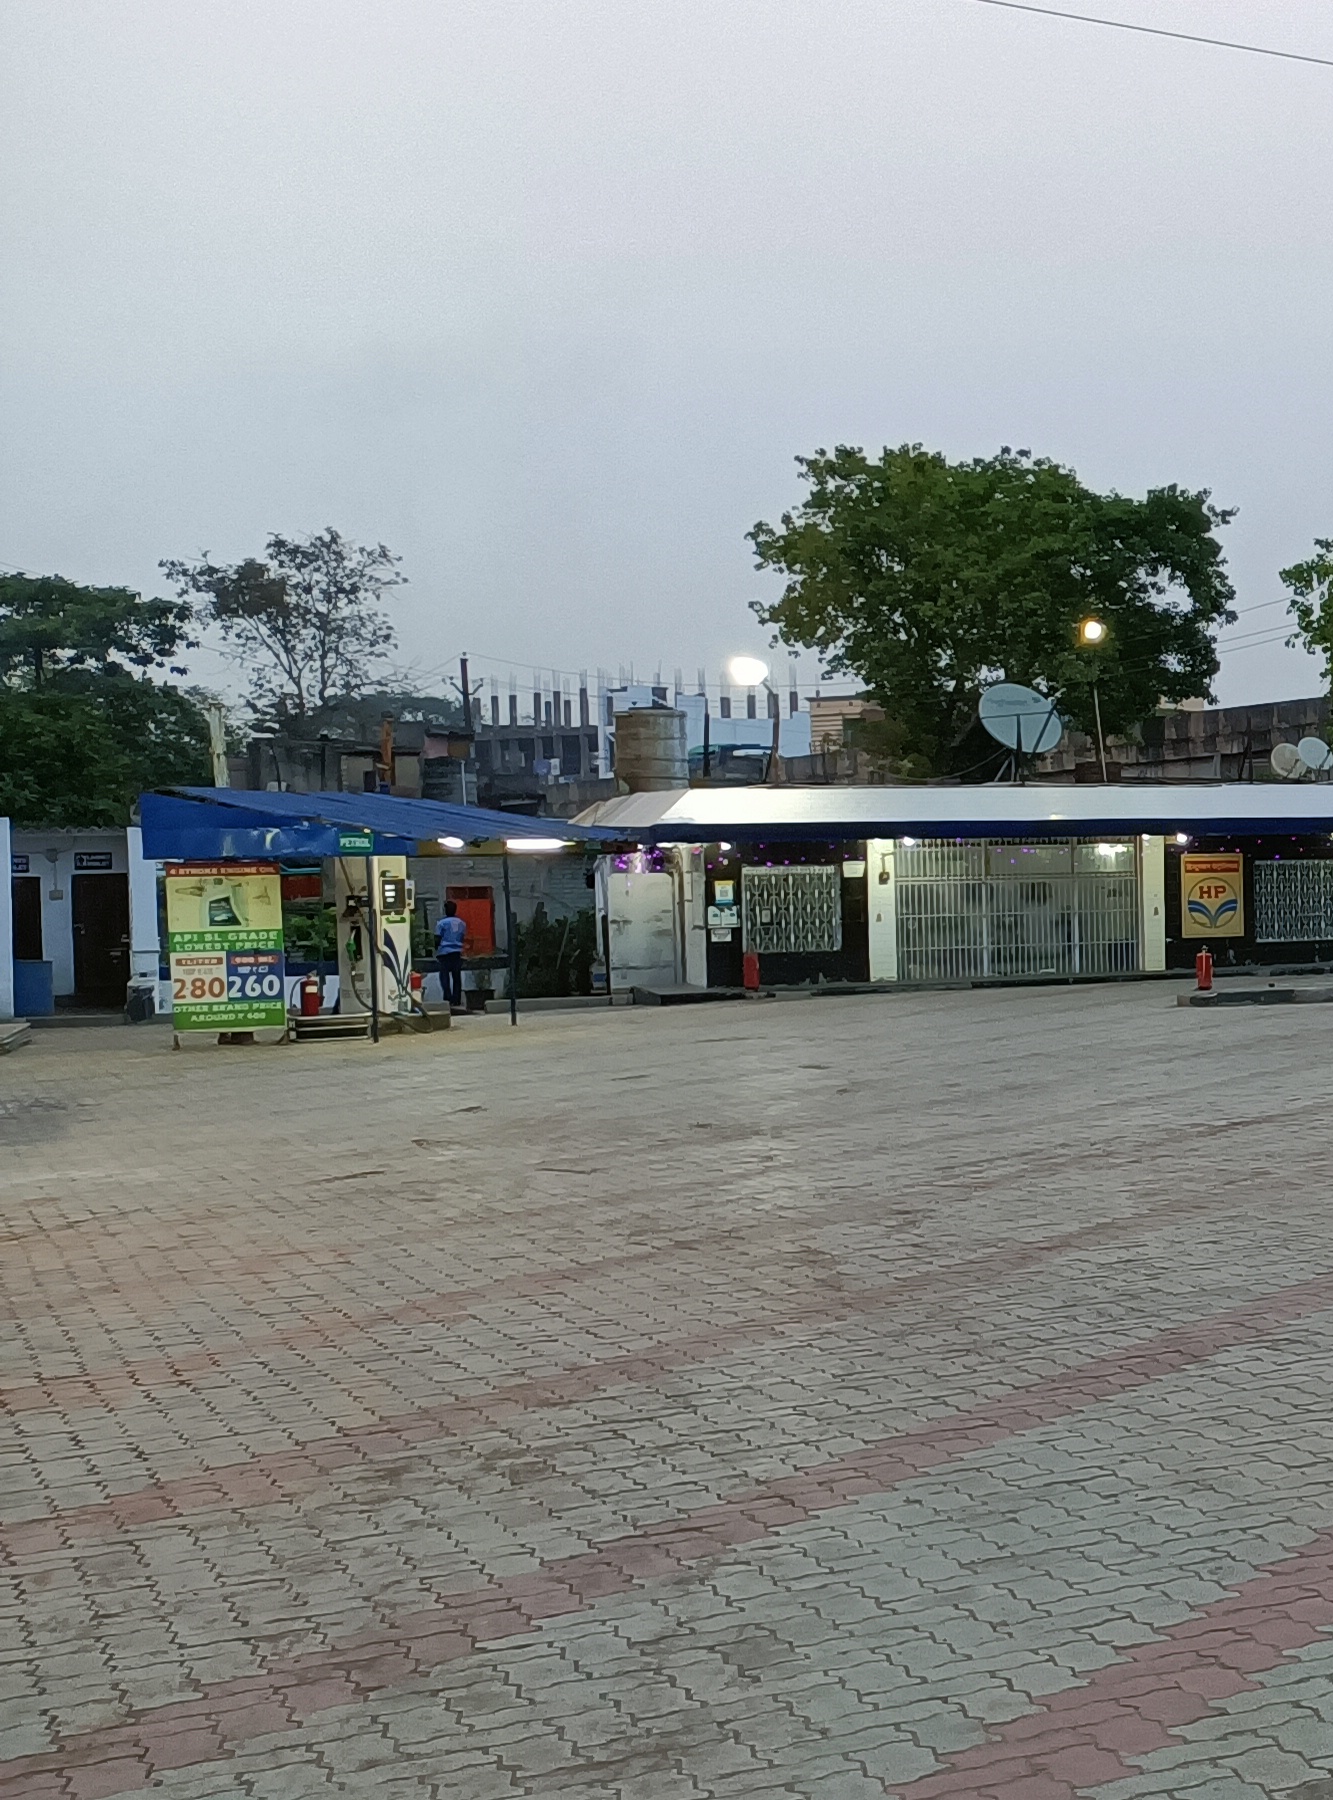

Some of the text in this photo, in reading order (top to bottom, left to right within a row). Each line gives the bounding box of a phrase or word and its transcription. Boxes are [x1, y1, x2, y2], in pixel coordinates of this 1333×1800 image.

[1198, 885, 1227, 899] HP
[173, 933, 198, 943] API
[227, 931, 278, 940] GRADE
[175, 941, 275, 951] LOWEST PRICE
[173, 976, 225, 1000] 280
[228, 974, 281, 998] 260
